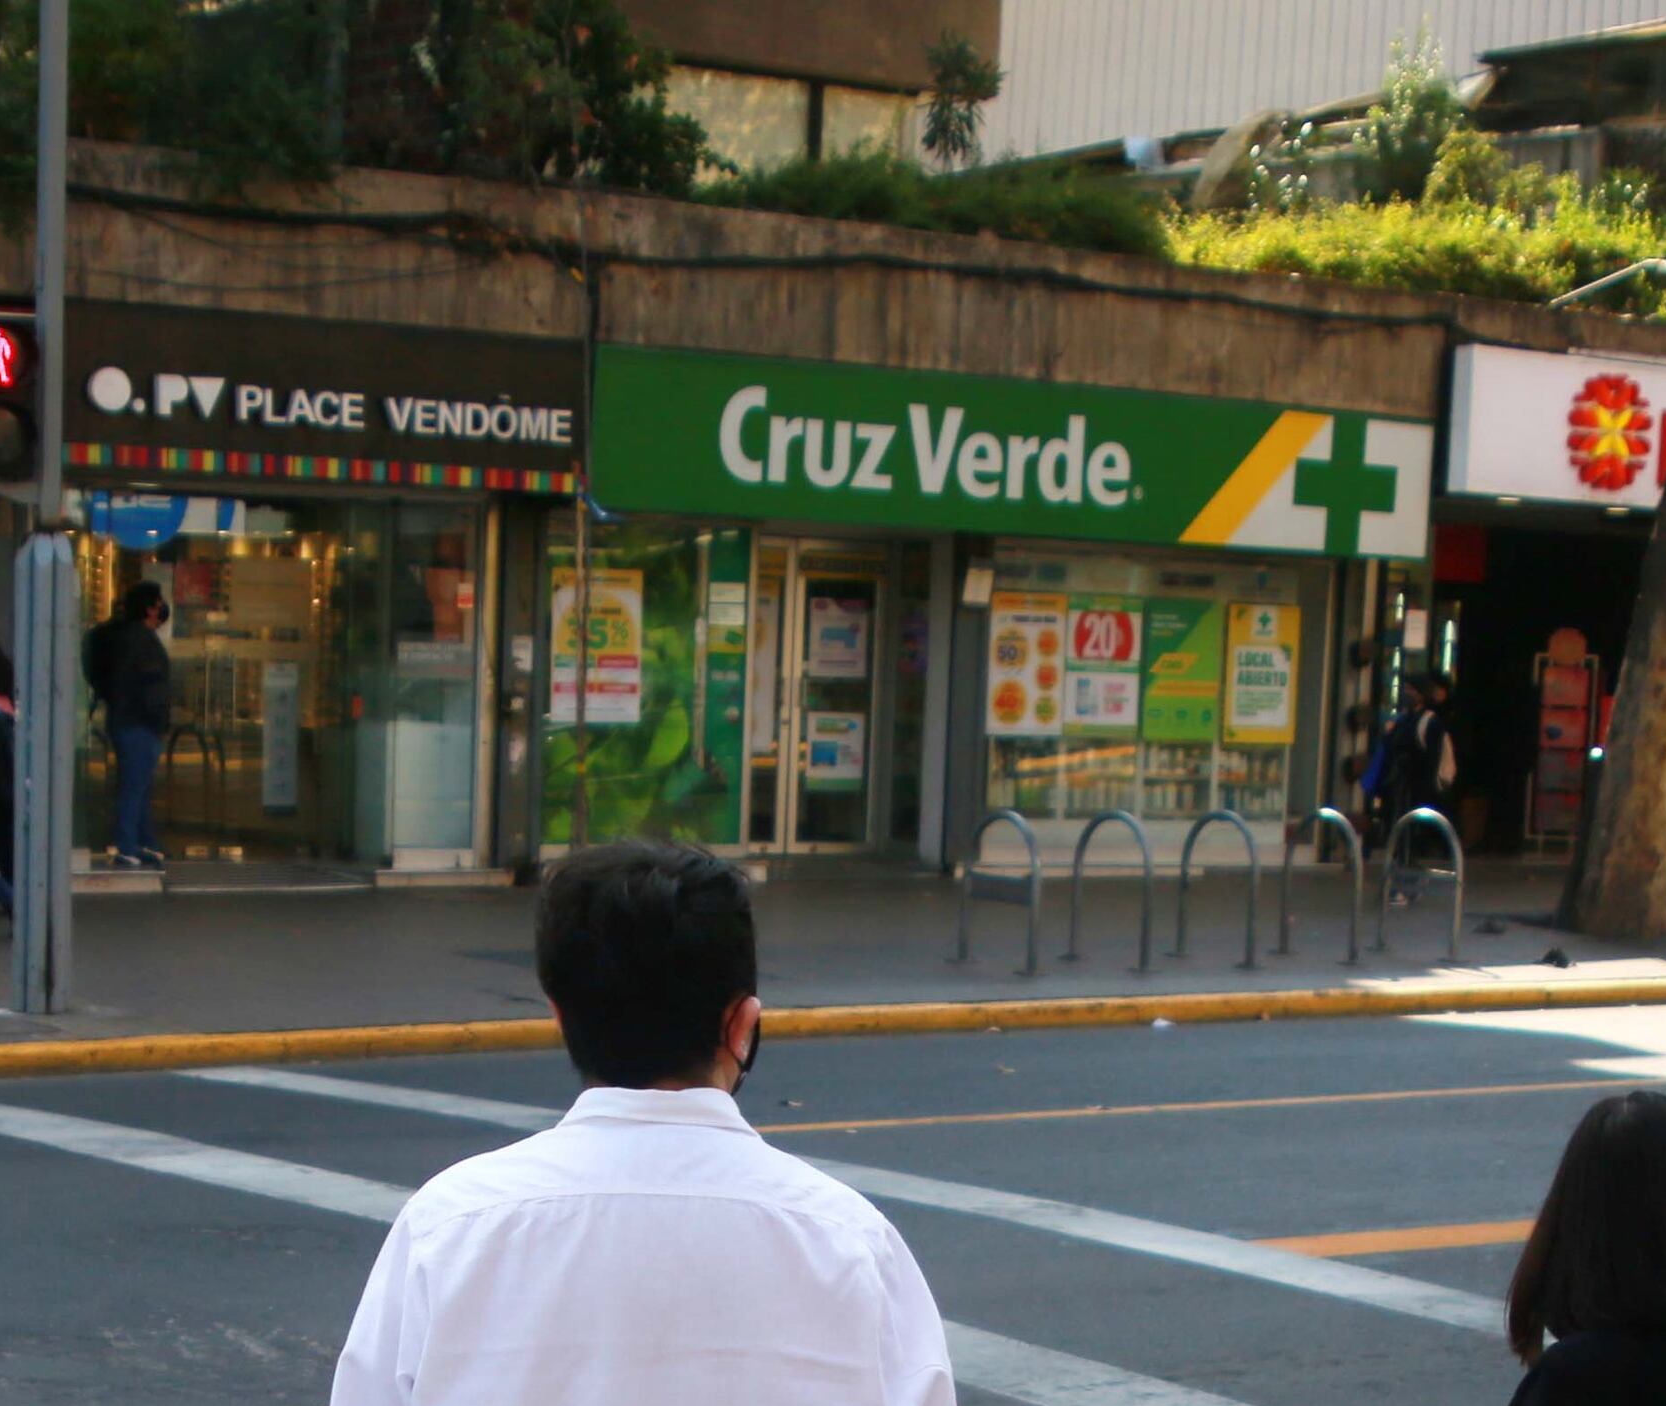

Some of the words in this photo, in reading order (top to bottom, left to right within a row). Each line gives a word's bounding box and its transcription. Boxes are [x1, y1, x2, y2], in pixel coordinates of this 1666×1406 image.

[236, 384, 366, 428] PLACE
[384, 394, 573, 444] VENDÔME
[718, 384, 897, 489] Cruz
[908, 402, 1132, 506] Verde
